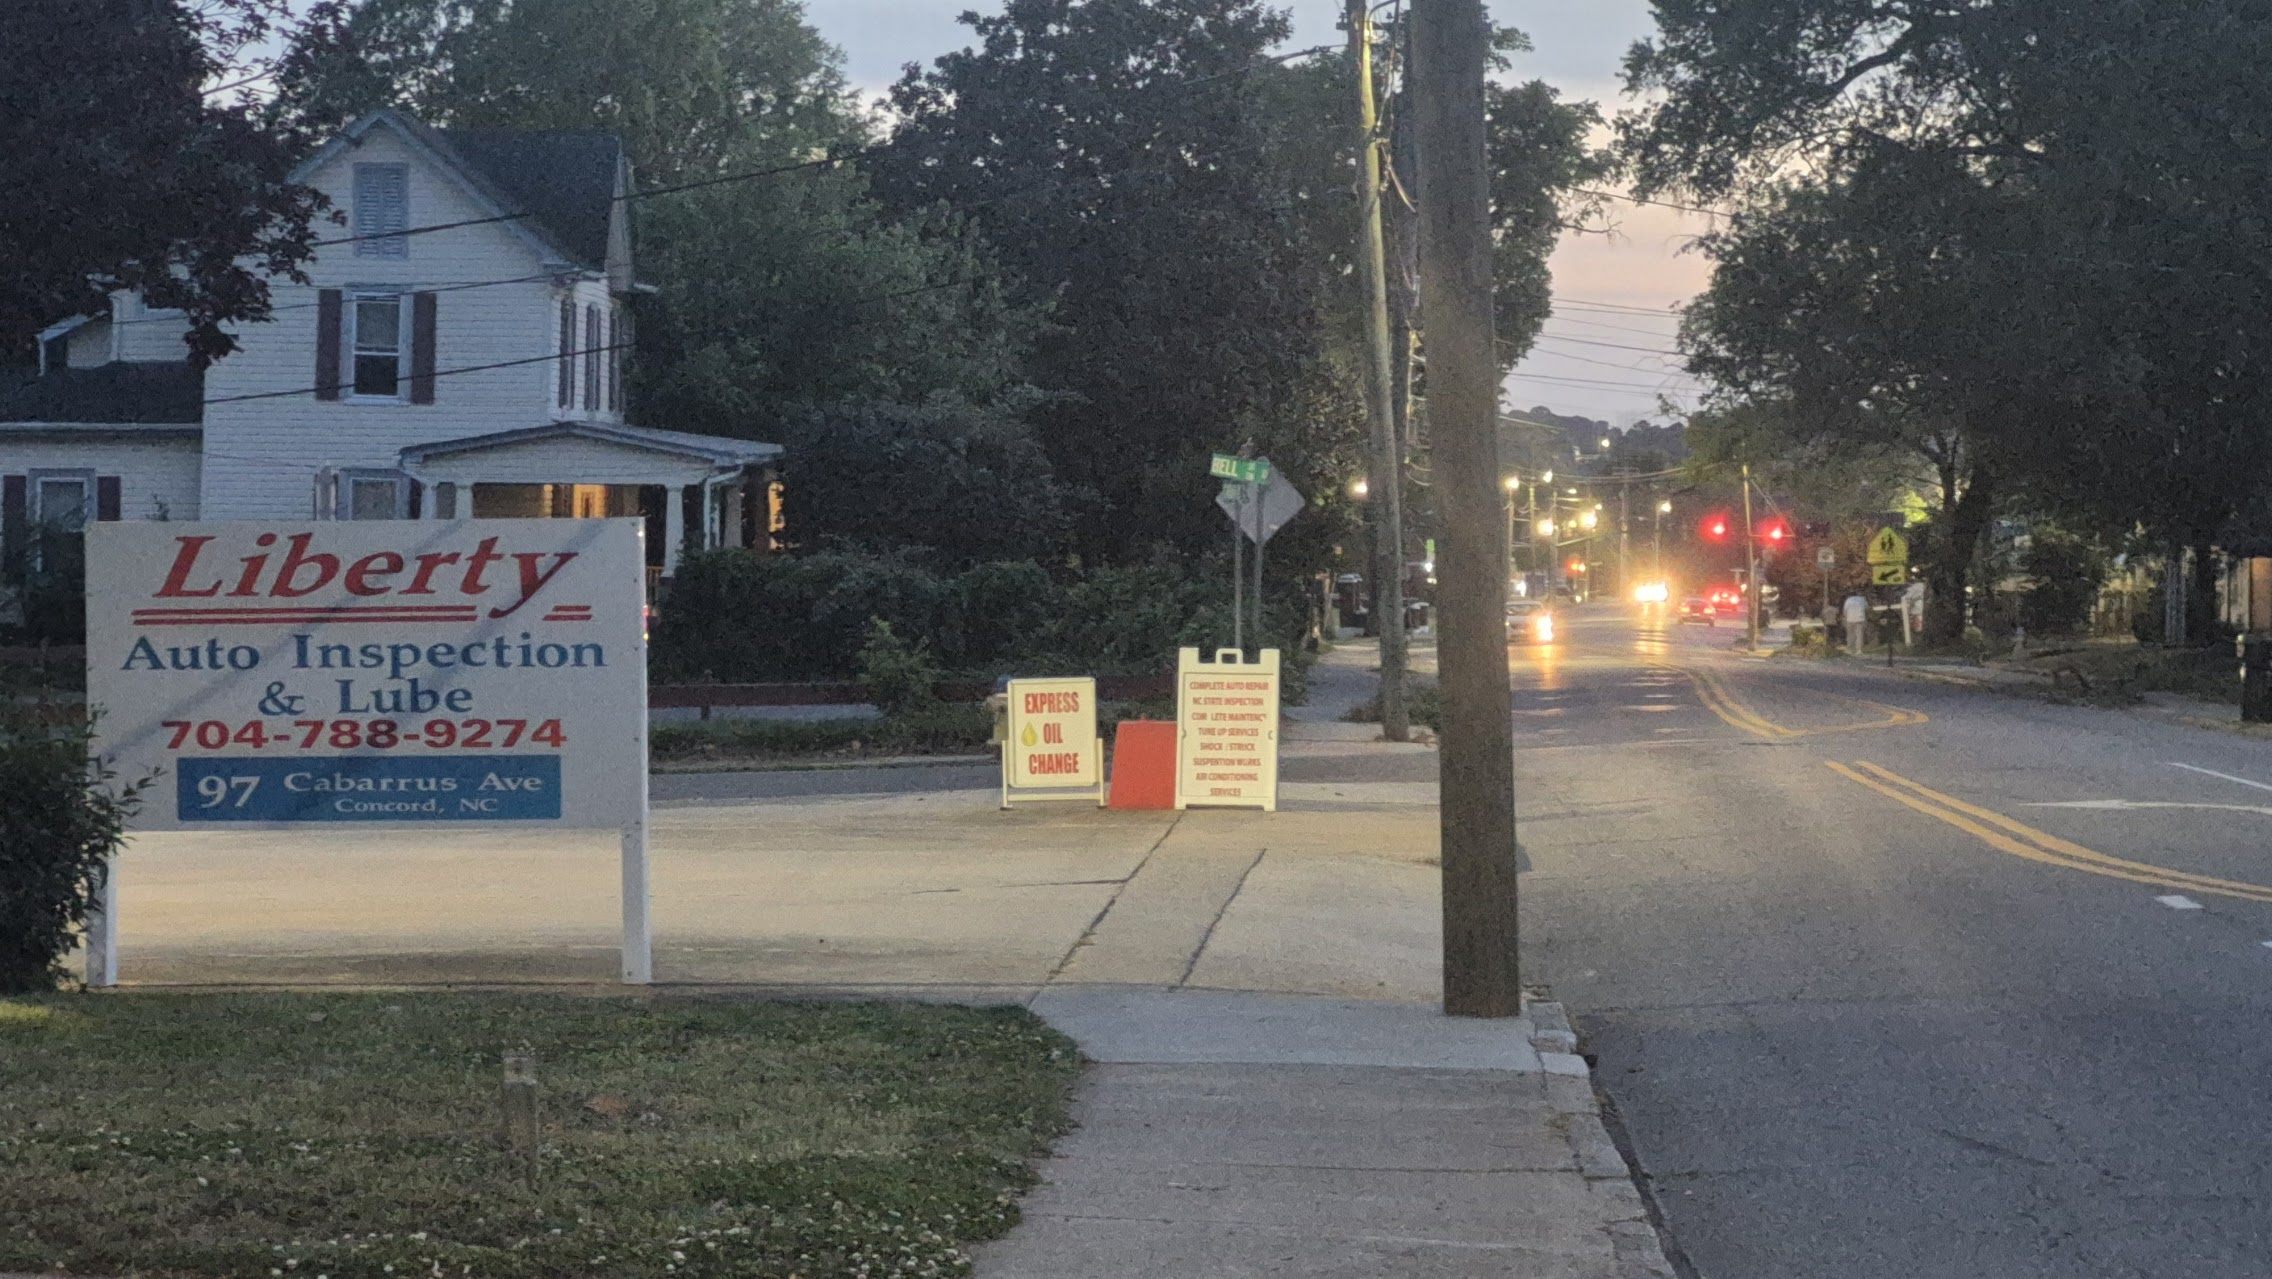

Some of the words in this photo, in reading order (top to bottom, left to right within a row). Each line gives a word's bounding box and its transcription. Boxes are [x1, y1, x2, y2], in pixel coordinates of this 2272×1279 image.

[153, 531, 578, 619] Liberty
[121, 636, 260, 671] Auto
[292, 631, 608, 678] Inspection
[1190, 682, 1225, 690] COMPLETE
[1226, 682, 1245, 690] AUTO
[1245, 682, 1269, 690] REPAIR
[258, 681, 304, 716] &
[338, 678, 473, 714] Lube
[1024, 692, 1080, 714] EXPRESS
[1203, 697, 1223, 705] STATE
[161, 718, 568, 751] 704-788-9274
[1043, 723, 1064, 744] OIL
[1198, 728, 1216, 736] TUNE
[1217, 728, 1227, 736] UP
[1228, 728, 1259, 737] SERVICES
[1028, 752, 1080, 775] CHANGE
[1195, 772, 1208, 781] AIR
[197, 775, 261, 808] 97
[283, 772, 458, 792] Cabarrus
[479, 772, 543, 791] Ave
[1210, 788, 1241, 797] SERVICES
[334, 798, 444, 813] Concord,
[459, 798, 498, 812] NC
